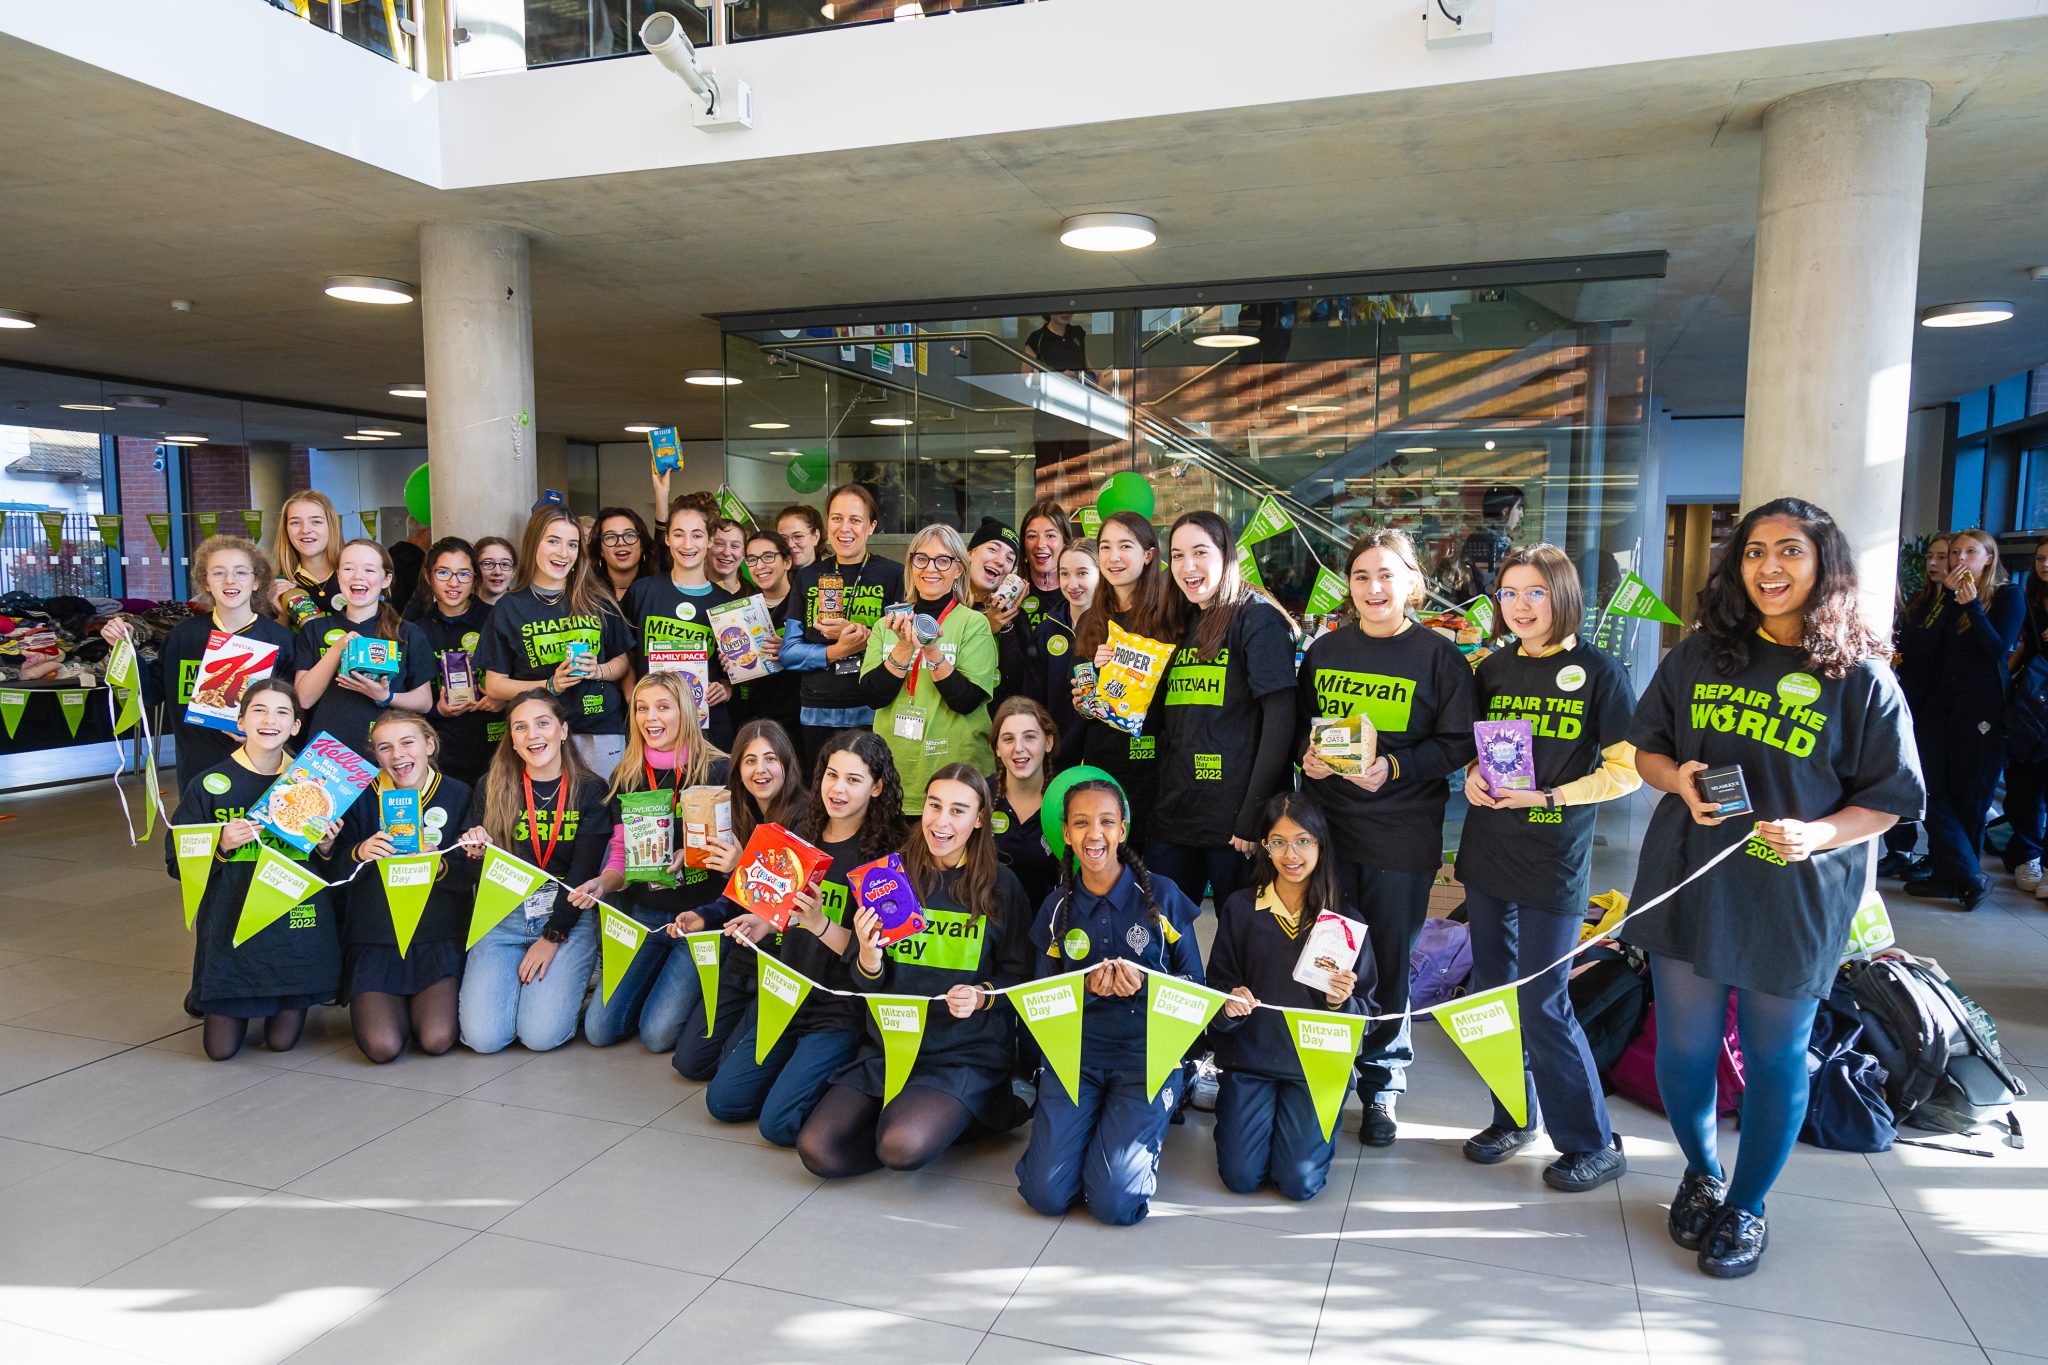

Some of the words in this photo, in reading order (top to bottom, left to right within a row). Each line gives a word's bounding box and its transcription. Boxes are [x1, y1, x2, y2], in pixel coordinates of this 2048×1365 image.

[1262, 507, 1273, 520] Day
[1268, 503, 1285, 526] Mitzvah
[1320, 580, 1332, 592] Day
[1324, 576, 1347, 594] Mitzvah
[1615, 582, 1635, 607] Mitzvah
[1621, 597, 1634, 610] Day
[521, 615, 601, 637] SHARING
[647, 620, 716, 648] Mitzvah
[231, 641, 254, 652] SPECIAL
[722, 635, 750, 652] Cheerios
[112, 642, 129, 676] Mitzvah
[522, 639, 539, 669] EVERY
[651, 653, 680, 661] FAMILY
[685, 652, 705, 660] PACK
[1114, 646, 1151, 671] PROPER
[116, 663, 127, 680] Day
[1127, 668, 1144, 680] CORN
[1167, 677, 1219, 694] MITZVAH
[1318, 674, 1407, 703] Mitzvah
[583, 705, 604, 715] 2022
[1319, 695, 1354, 718] Day
[1490, 695, 1541, 712] REPAIR
[1546, 697, 1584, 715] THE
[1693, 683, 1772, 710] REPAIR
[1777, 697, 1828, 732] THE
[1691, 703, 1817, 758] WORLD
[1130, 750, 1155, 760] 2022
[311, 759, 341, 784] Krispies
[322, 758, 339, 774] Rice
[1196, 760, 1208, 768] Day
[1195, 769, 1222, 780] 2022
[1528, 811, 1562, 823] 2023
[629, 821, 652, 833] Veggie
[632, 828, 657, 840] Straws
[182, 836, 211, 845] Mitzvah
[181, 845, 196, 855] Day
[268, 863, 305, 890] Mitzvah
[391, 865, 429, 874] Mitzvah
[489, 868, 509, 884] Day
[493, 860, 530, 885] Mitzvah
[262, 870, 282, 886] Day
[391, 875, 411, 885] Day
[686, 871, 709, 886] 2023
[865, 880, 898, 902] Wispa
[291, 904, 313, 913] Mitzvah
[291, 910, 304, 918] Day
[289, 917, 317, 929] 2022
[606, 923, 621, 939] Day
[608, 917, 637, 939] Mitzvah
[694, 943, 715, 954] Mitzvah
[763, 977, 780, 993] Day
[766, 967, 798, 994] Mitzvah
[1026, 989, 1071, 1008] Mitzvah
[1156, 998, 1180, 1014] Day
[1160, 988, 1205, 1012] Mitzvah
[881, 1008, 917, 1019] Mitzvah
[1029, 1005, 1052, 1018] Day
[1455, 1005, 1505, 1028] Mitzvah
[883, 1017, 901, 1029] Day
[1301, 1023, 1348, 1037] Mitzvah
[1459, 1023, 1485, 1038] Day
[1302, 1033, 1325, 1047] Day
